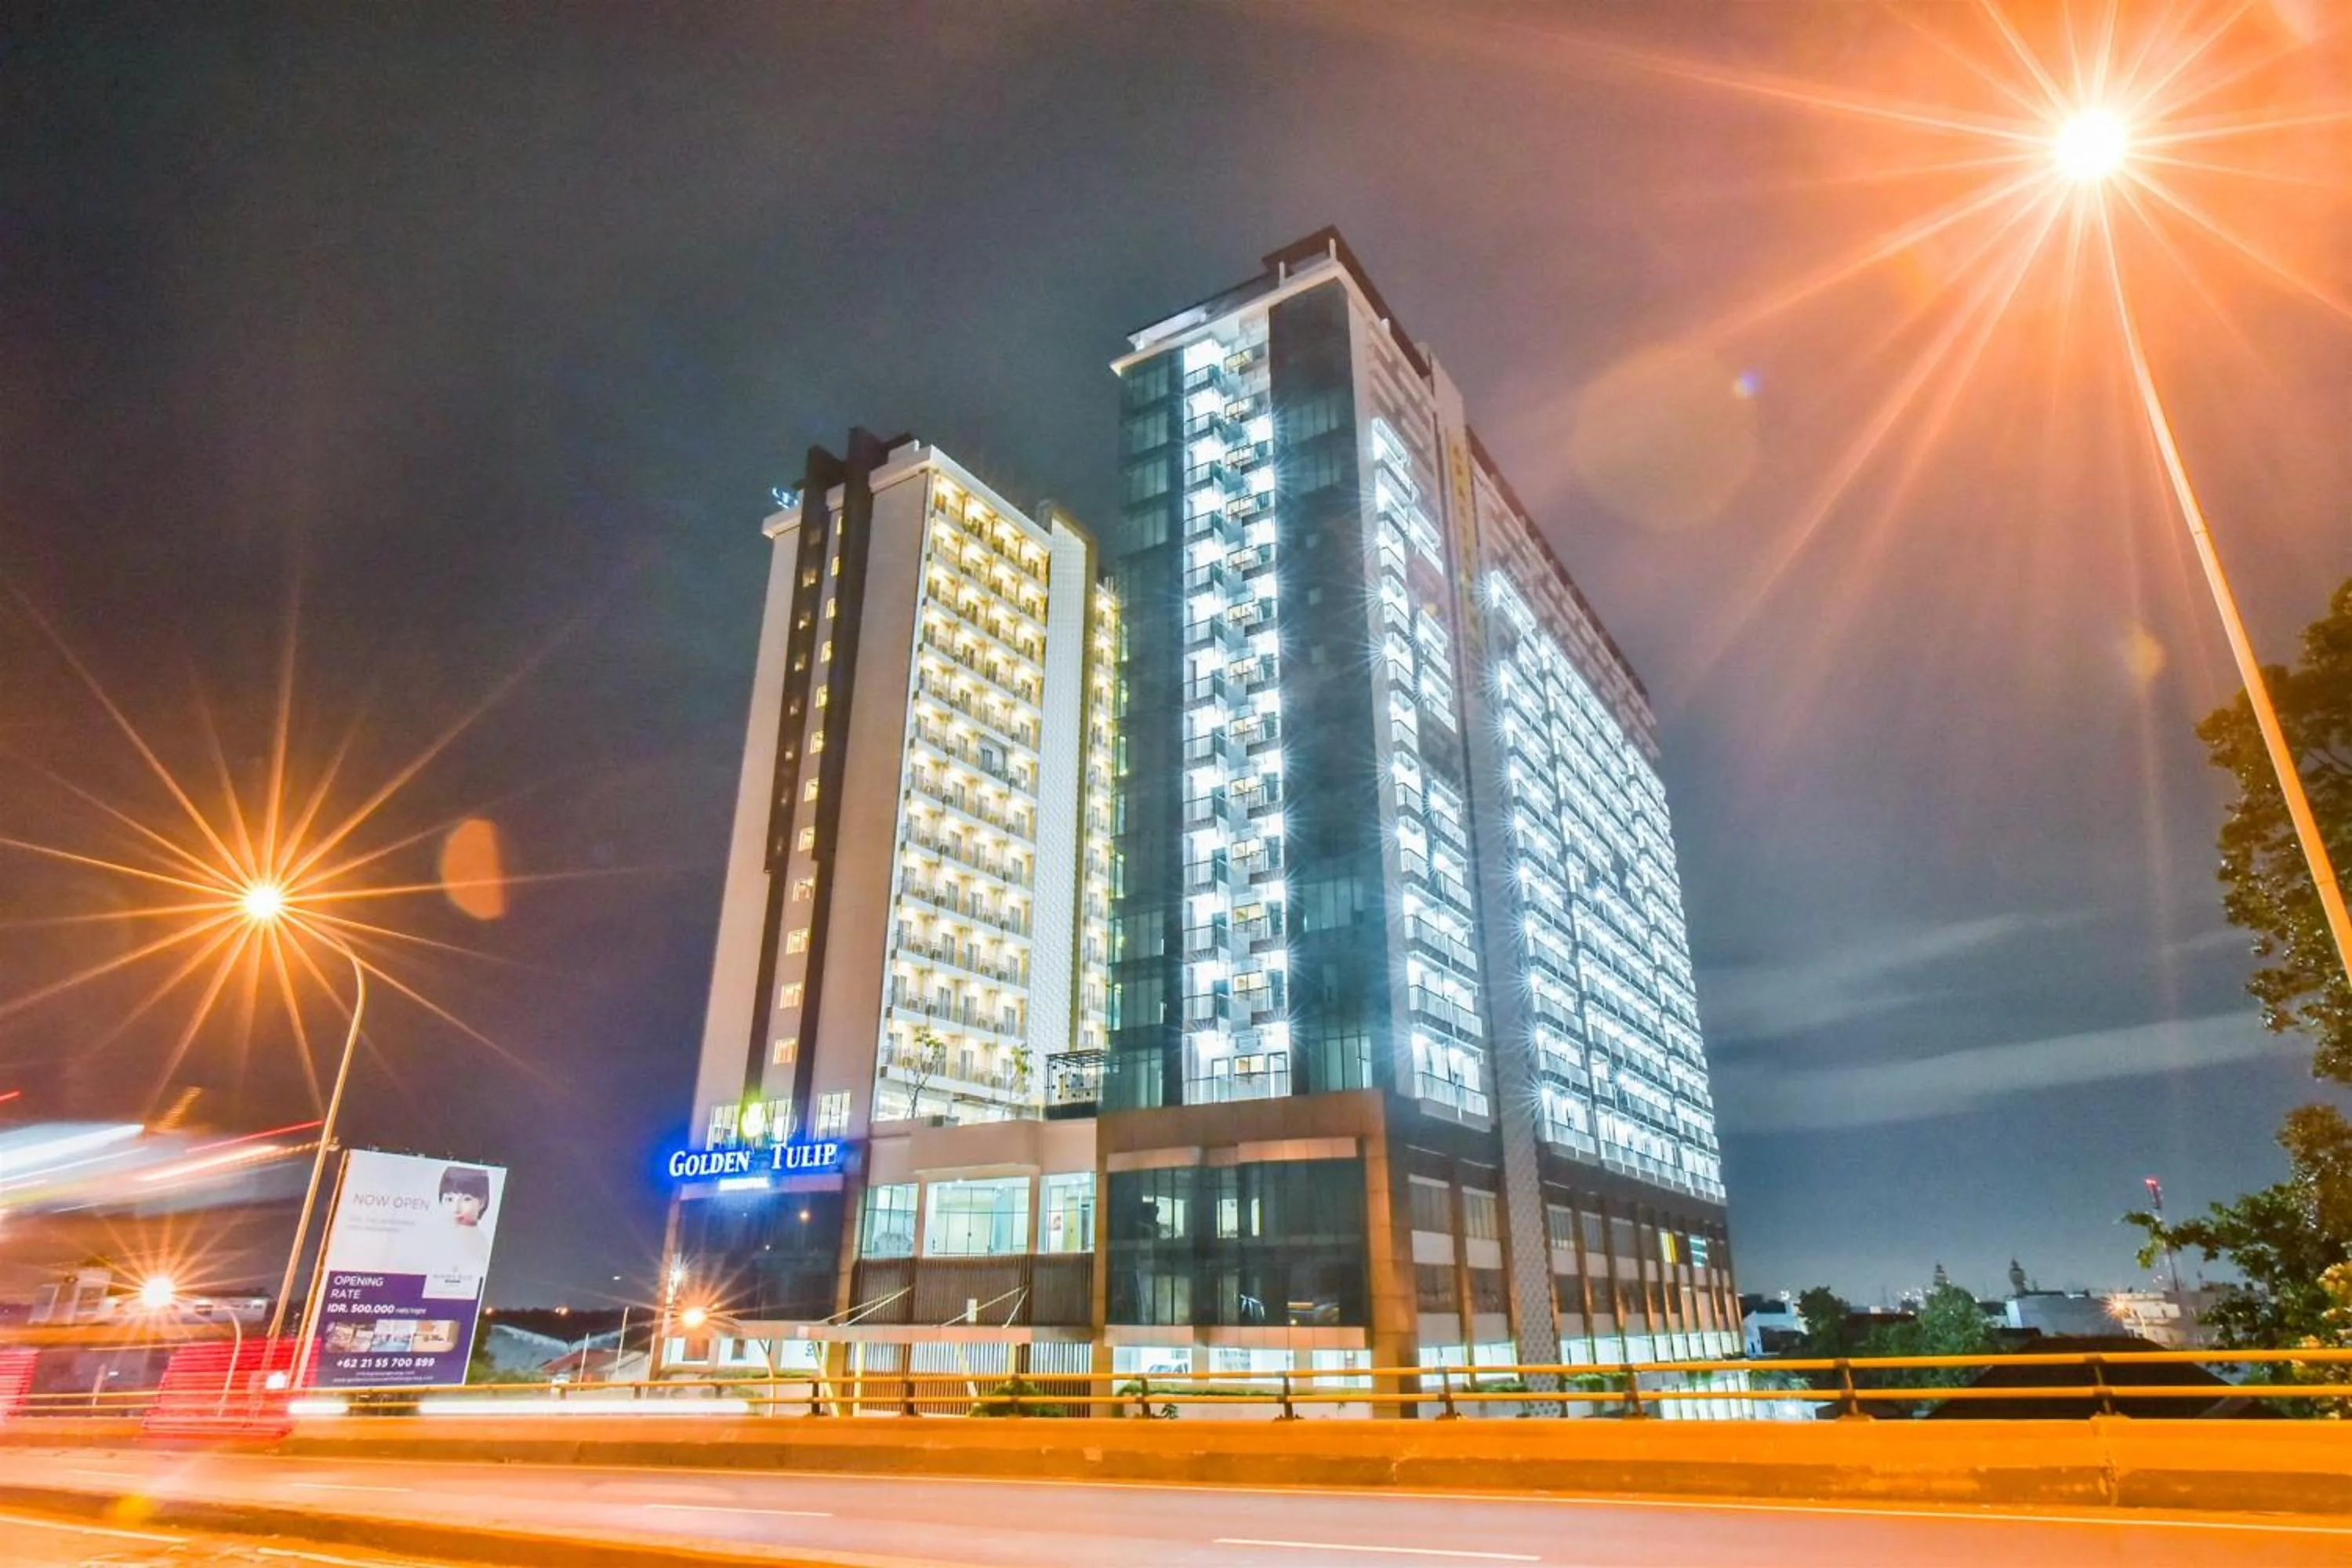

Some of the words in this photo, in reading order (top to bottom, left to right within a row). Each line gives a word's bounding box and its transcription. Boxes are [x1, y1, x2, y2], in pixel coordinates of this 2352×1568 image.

[669, 1150, 750, 1177] GOLDEN
[770, 1142, 837, 1170] TULIP
[353, 1192, 390, 1207] NOW
[393, 1196, 430, 1211] OPEN
[333, 1275, 384, 1287] OPENING
[330, 1288, 361, 1299] RATE
[327, 1302, 348, 1313] IDR.
[350, 1303, 395, 1314] 500.000
[336, 1357, 358, 1368] +62
[360, 1357, 372, 1368] 21
[391, 1357, 413, 1368] 700
